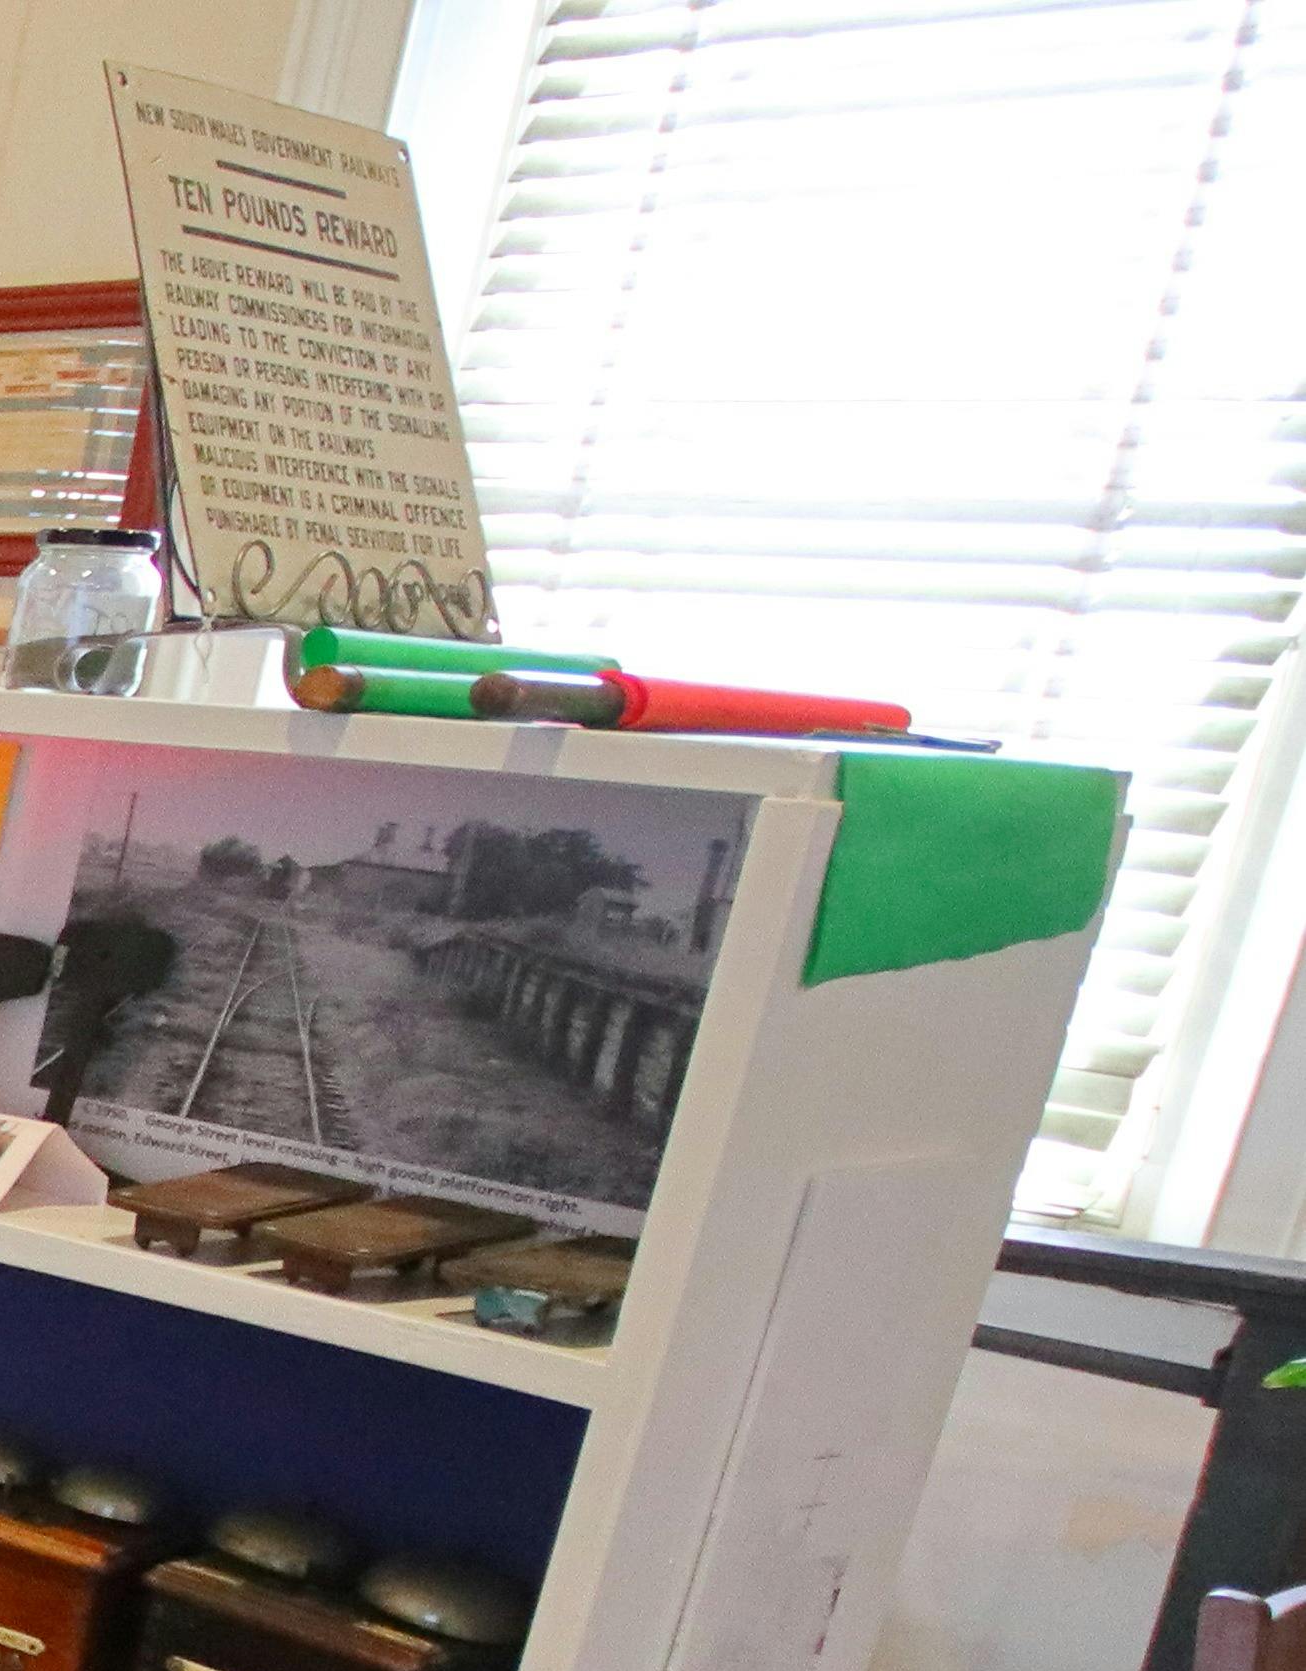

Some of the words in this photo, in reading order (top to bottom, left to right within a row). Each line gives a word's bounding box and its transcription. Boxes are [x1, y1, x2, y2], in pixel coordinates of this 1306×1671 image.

[135, 101, 165, 126] NEW
[169, 108, 207, 136] SOUTH
[207, 117, 246, 147] WALES
[251, 129, 333, 169] GOVERNMENT
[339, 153, 400, 188] RAILWAYS
[168, 174, 213, 215] TEN
[221, 187, 307, 237] POUNDS
[315, 210, 398, 259] REWARD
[160, 249, 185, 275] THE
[192, 256, 231, 282] ABOVE
[234, 263, 294, 295] REWARD
[301, 279, 328, 303] WILL
[332, 284, 348, 306] BE
[352, 288, 377, 313] PAID
[379, 294, 392, 316] BY
[397, 299, 420, 322] THE
[165, 282, 219, 312] RAILWAY
[228, 293, 328, 332] COMMISSIONERS
[333, 314, 353, 337] FOR
[360, 320, 432, 353] INFORMATION
[170, 314, 231, 345] LEADING
[238, 325, 258, 350] TO
[262, 331, 288, 355] THE
[298, 337, 378, 372] CONVICTION
[382, 353, 399, 375] OF
[406, 359, 431, 383] ANY
[175, 347, 229, 375] PERSON
[232, 355, 251, 380] OR
[254, 360, 310, 390] PERSONS
[315, 371, 392, 404] INTERFERING
[395, 384, 424, 410] WITH
[429, 391, 446, 413] OR
[182, 378, 247, 409] DAMAGING
[254, 390, 276, 414] ANY
[282, 395, 334, 424] PORTION
[339, 404, 353, 426] OF
[359, 407, 383, 431] THE
[387, 412, 450, 442] SIGNALLING
[188, 411, 260, 442] EQUIPMENT
[269, 422, 287, 447] ON
[290, 426, 314, 451] THE
[318, 431, 376, 459] RAILWAYS
[193, 442, 259, 473] MALICIOUS
[264, 453, 351, 487] INTERFERENCE
[355, 467, 384, 490] WITH
[388, 470, 409, 494] THE
[413, 475, 461, 500] SIGNALS
[200, 474, 217, 497] OR
[222, 477, 295, 507] EQUIPMENT
[300, 488, 313, 510] IS
[316, 490, 327, 513] A
[331, 494, 399, 522] CRIMINAL
[404, 503, 467, 531] OFFENCE
[205, 507, 281, 538] PUNISHABLE
[286, 517, 299, 540] BY
[305, 520, 343, 546] PENAL
[347, 526, 408, 553] SERVITUDE
[412, 534, 433, 555] FOR
[440, 537, 464, 560] LIFE
[134, 1131, 187, 1153] Edward
[188, 1141, 232, 1167] Street,
[145, 1114, 193, 1136] George
[197, 1125, 239, 1145] Street
[243, 1131, 276, 1151] level
[278, 1142, 338, 1167] crossing
[354, 1156, 385, 1177] high
[388, 1167, 434, 1185] goods
[440, 1175, 510, 1200] platform
[514, 1190, 533, 1205] on
[537, 1194, 582, 1218] right.
